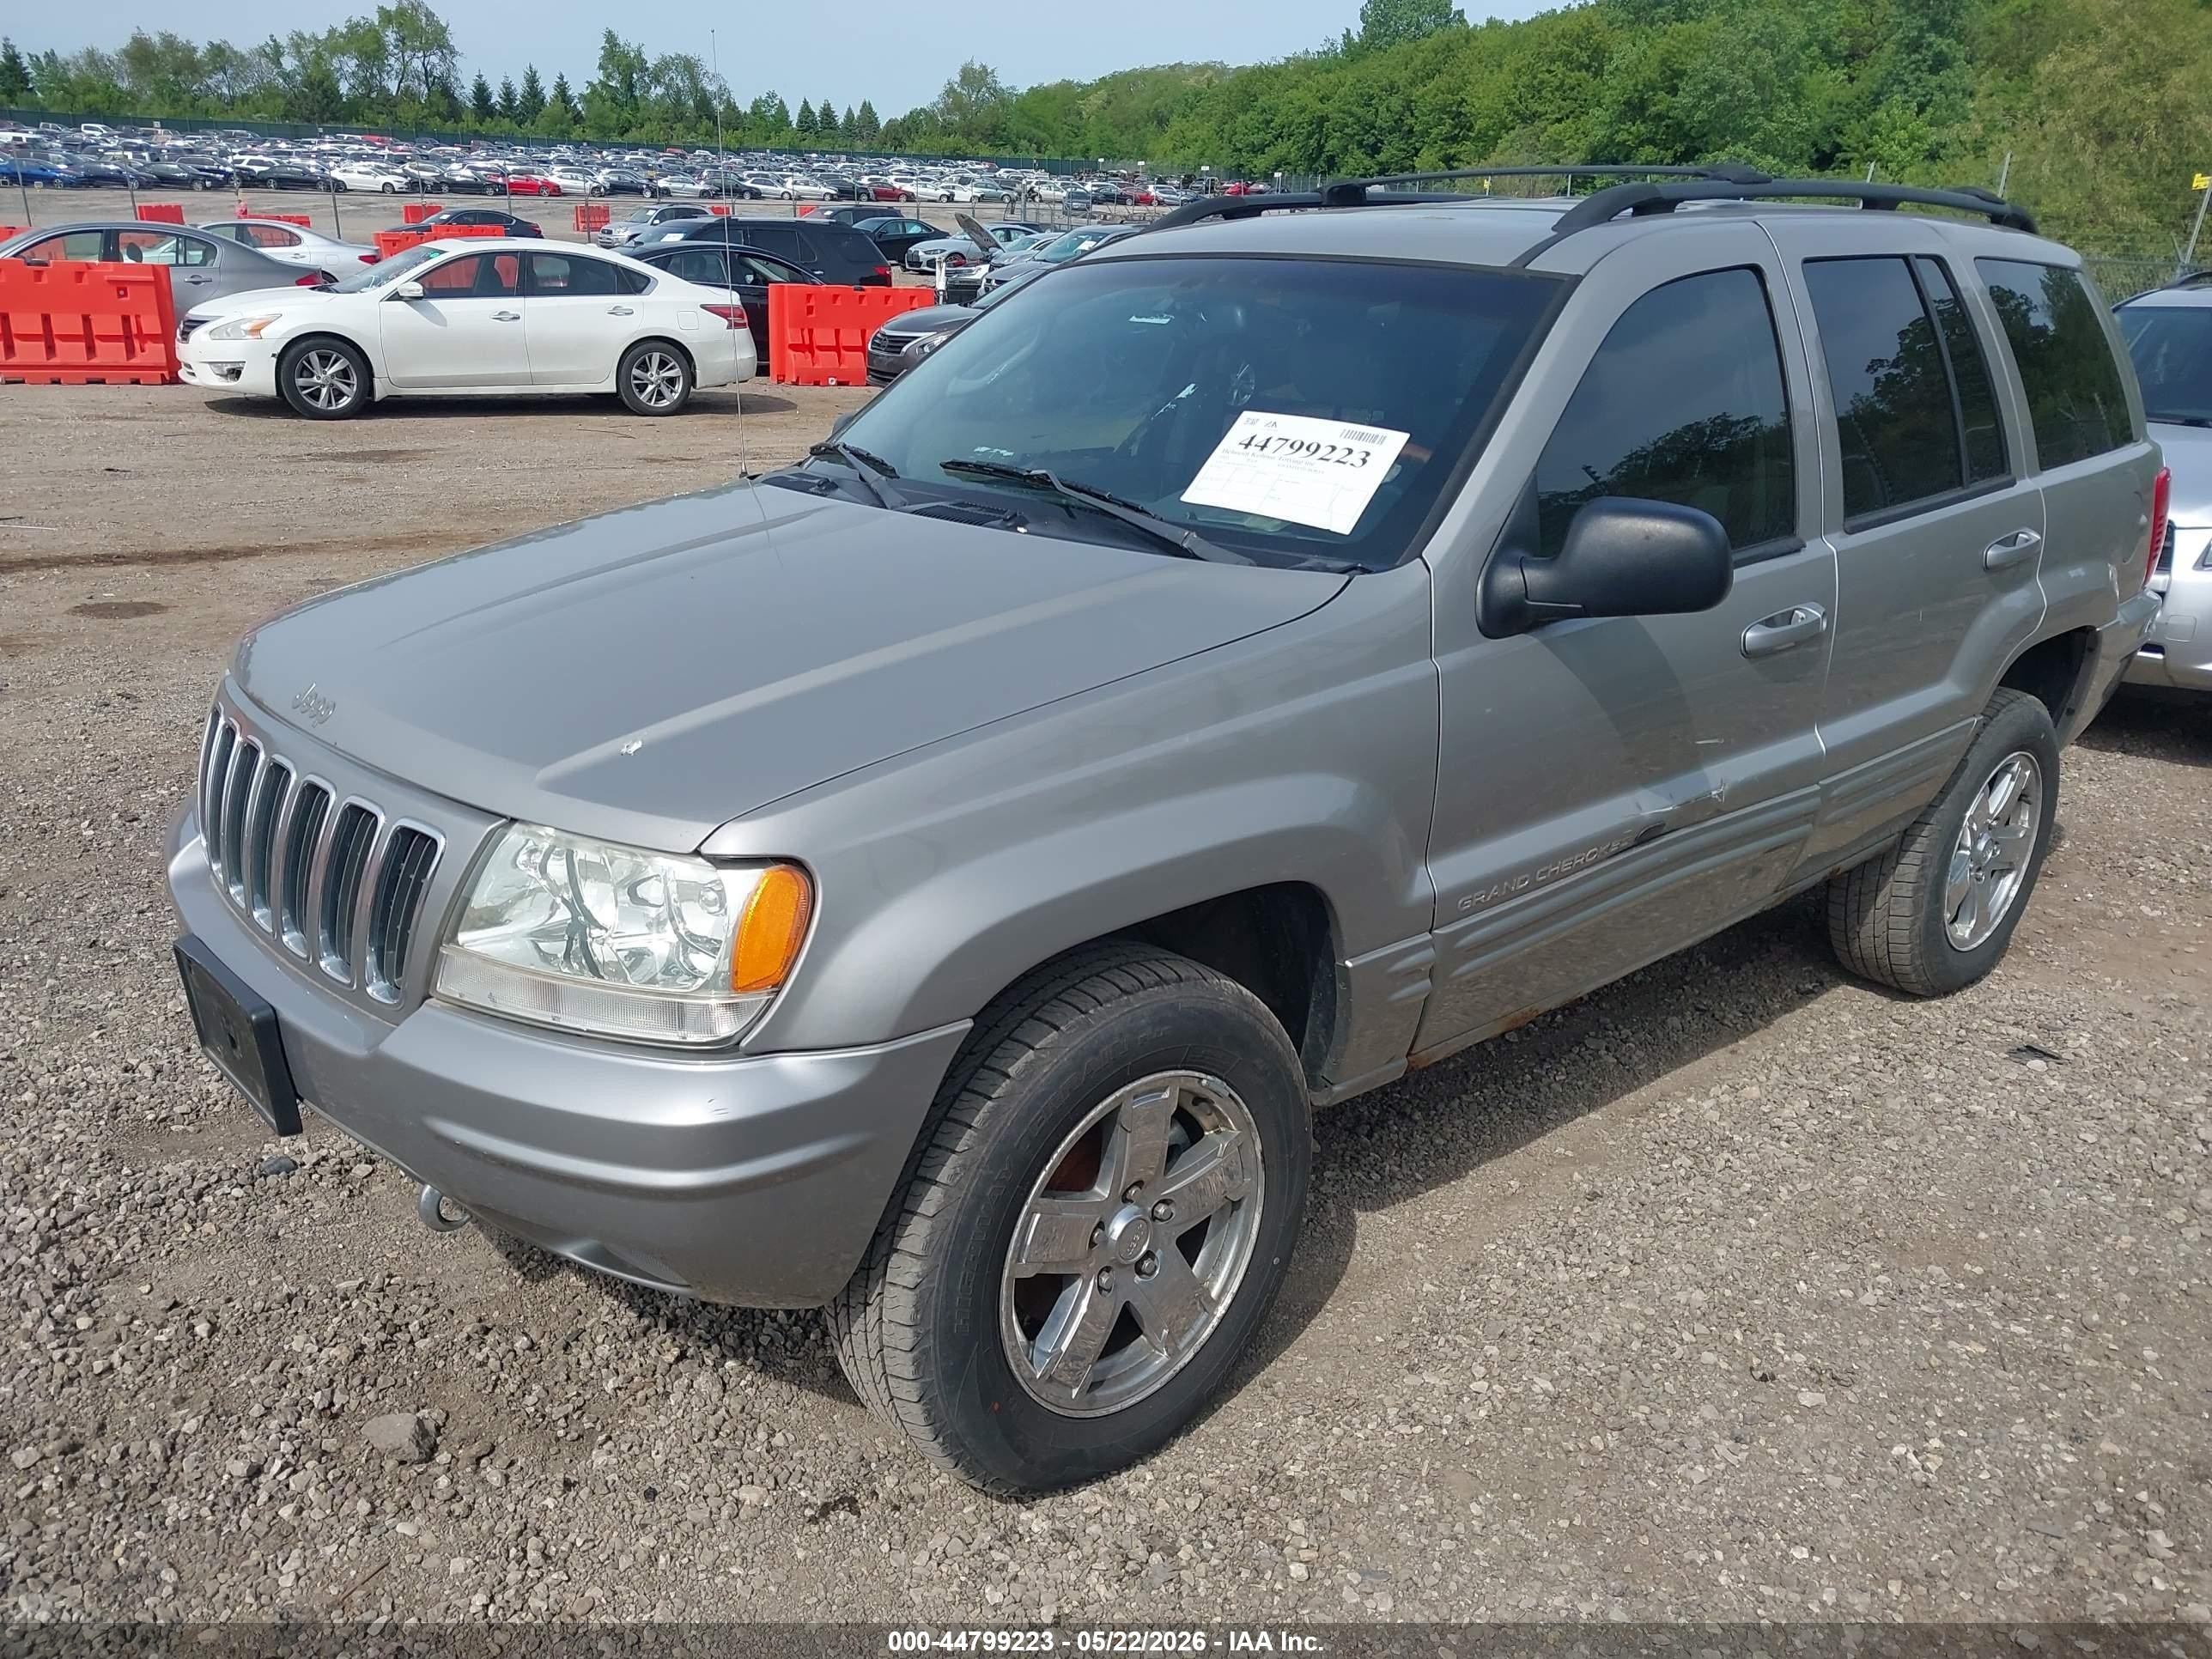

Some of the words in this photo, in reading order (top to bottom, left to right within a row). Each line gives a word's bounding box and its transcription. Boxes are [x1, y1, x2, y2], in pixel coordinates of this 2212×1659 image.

[1237, 434, 1371, 468] 44799223
[292, 682, 337, 728] Jeep
[1456, 873, 1529, 912] GRAND
